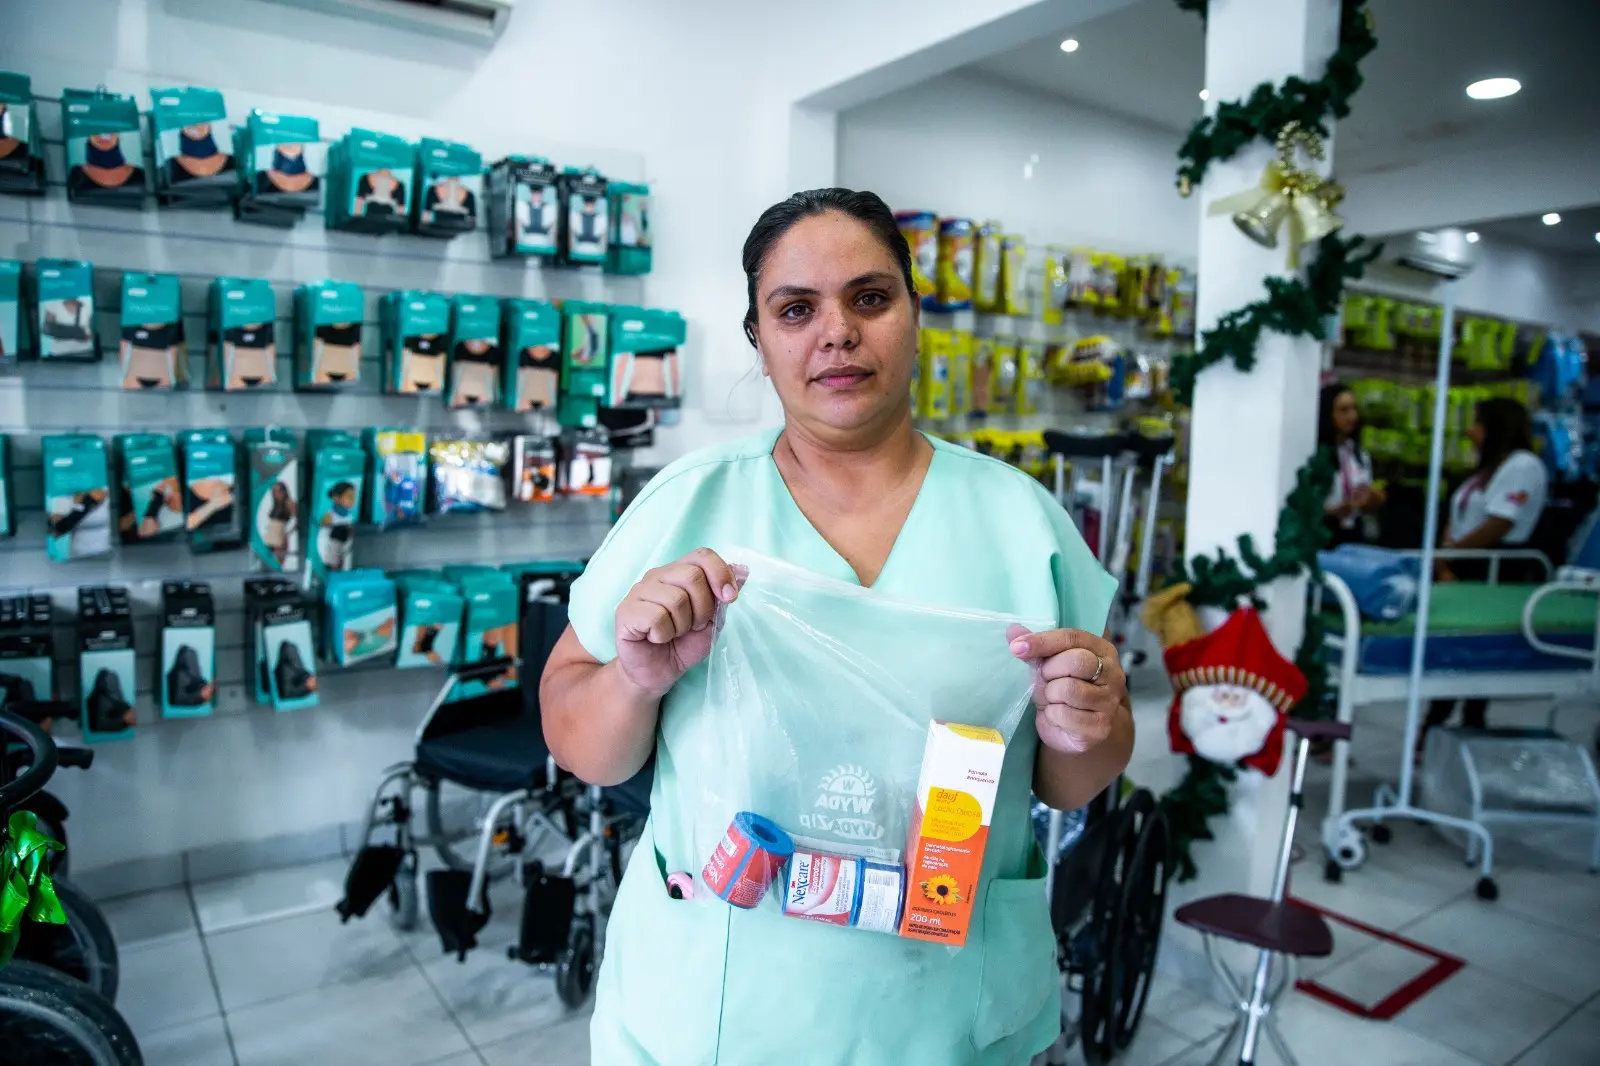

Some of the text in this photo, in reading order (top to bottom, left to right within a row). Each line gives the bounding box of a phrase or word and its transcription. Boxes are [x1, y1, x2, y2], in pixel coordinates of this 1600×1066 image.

[792, 861, 810, 905] Nexcare
[910, 913, 941, 925] 200 ml
